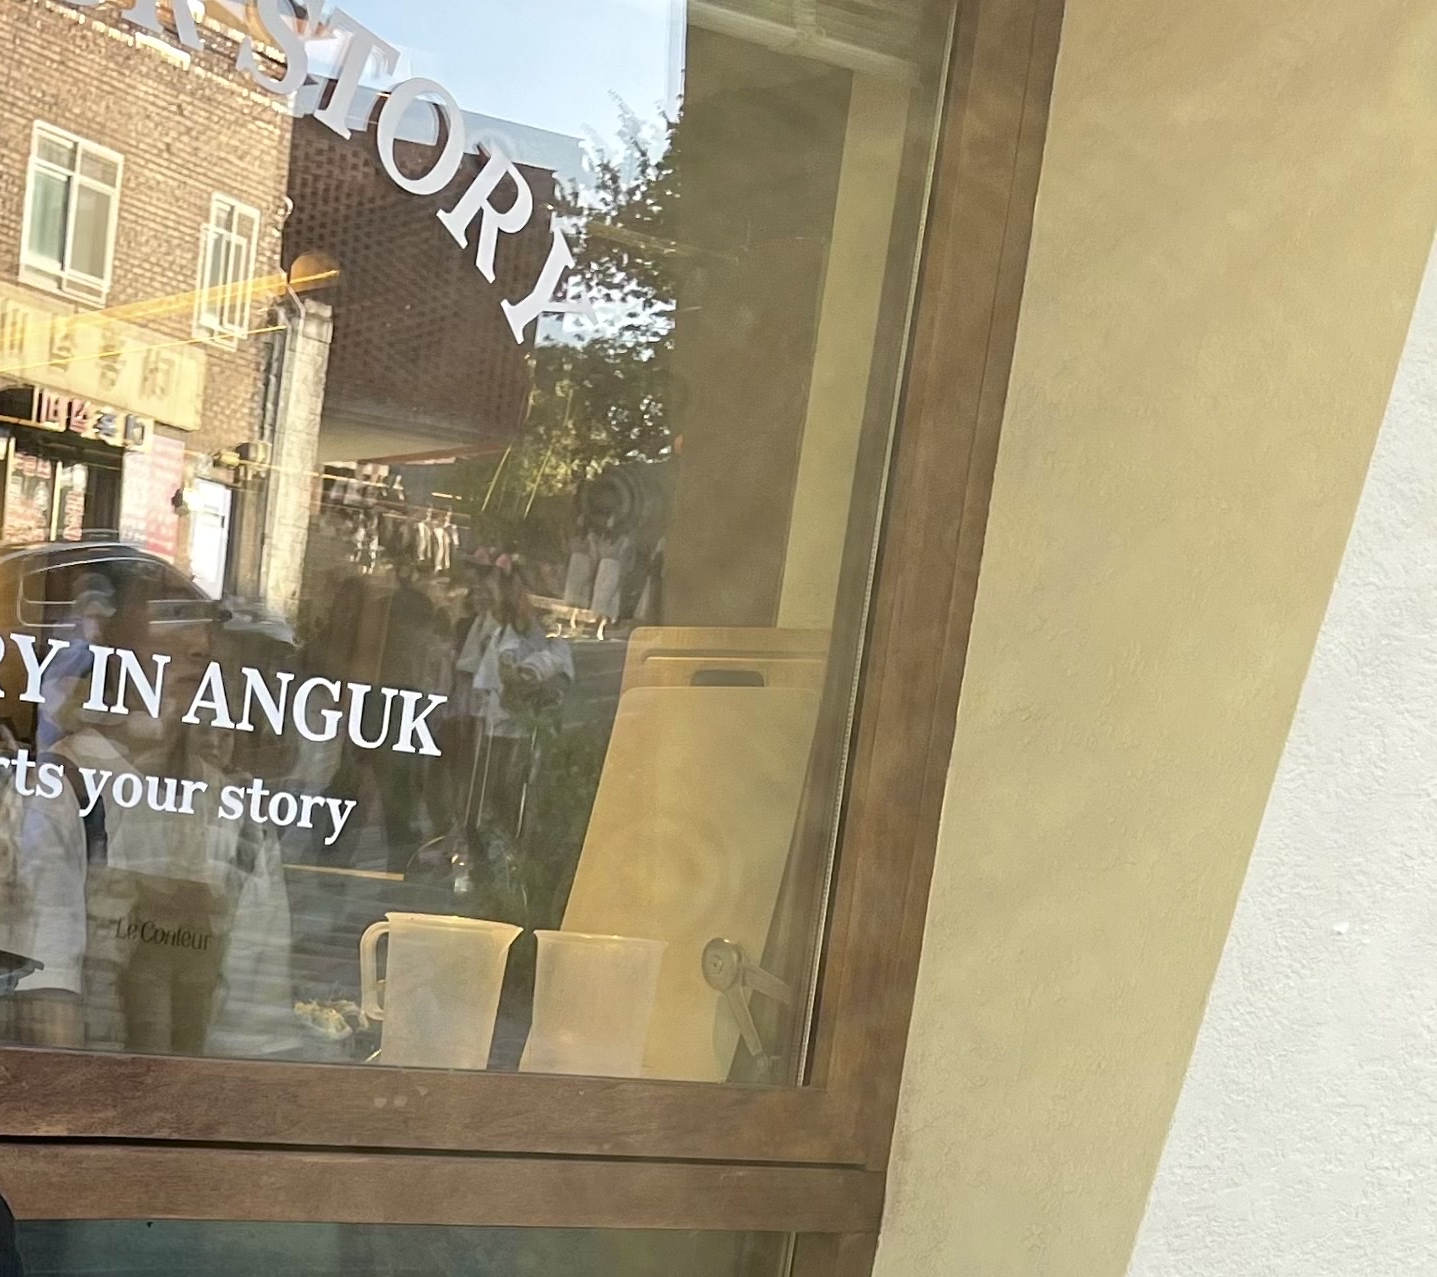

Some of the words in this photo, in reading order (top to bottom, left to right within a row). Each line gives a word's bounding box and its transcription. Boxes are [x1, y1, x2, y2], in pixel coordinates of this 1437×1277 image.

[236, 0, 598, 344] STORY
[83, 645, 170, 718] IN
[182, 662, 447, 757] ANGUK
[79, 767, 208, 818] your
[217, 785, 356, 846] story
[141, 920, 213, 950] Conteur
